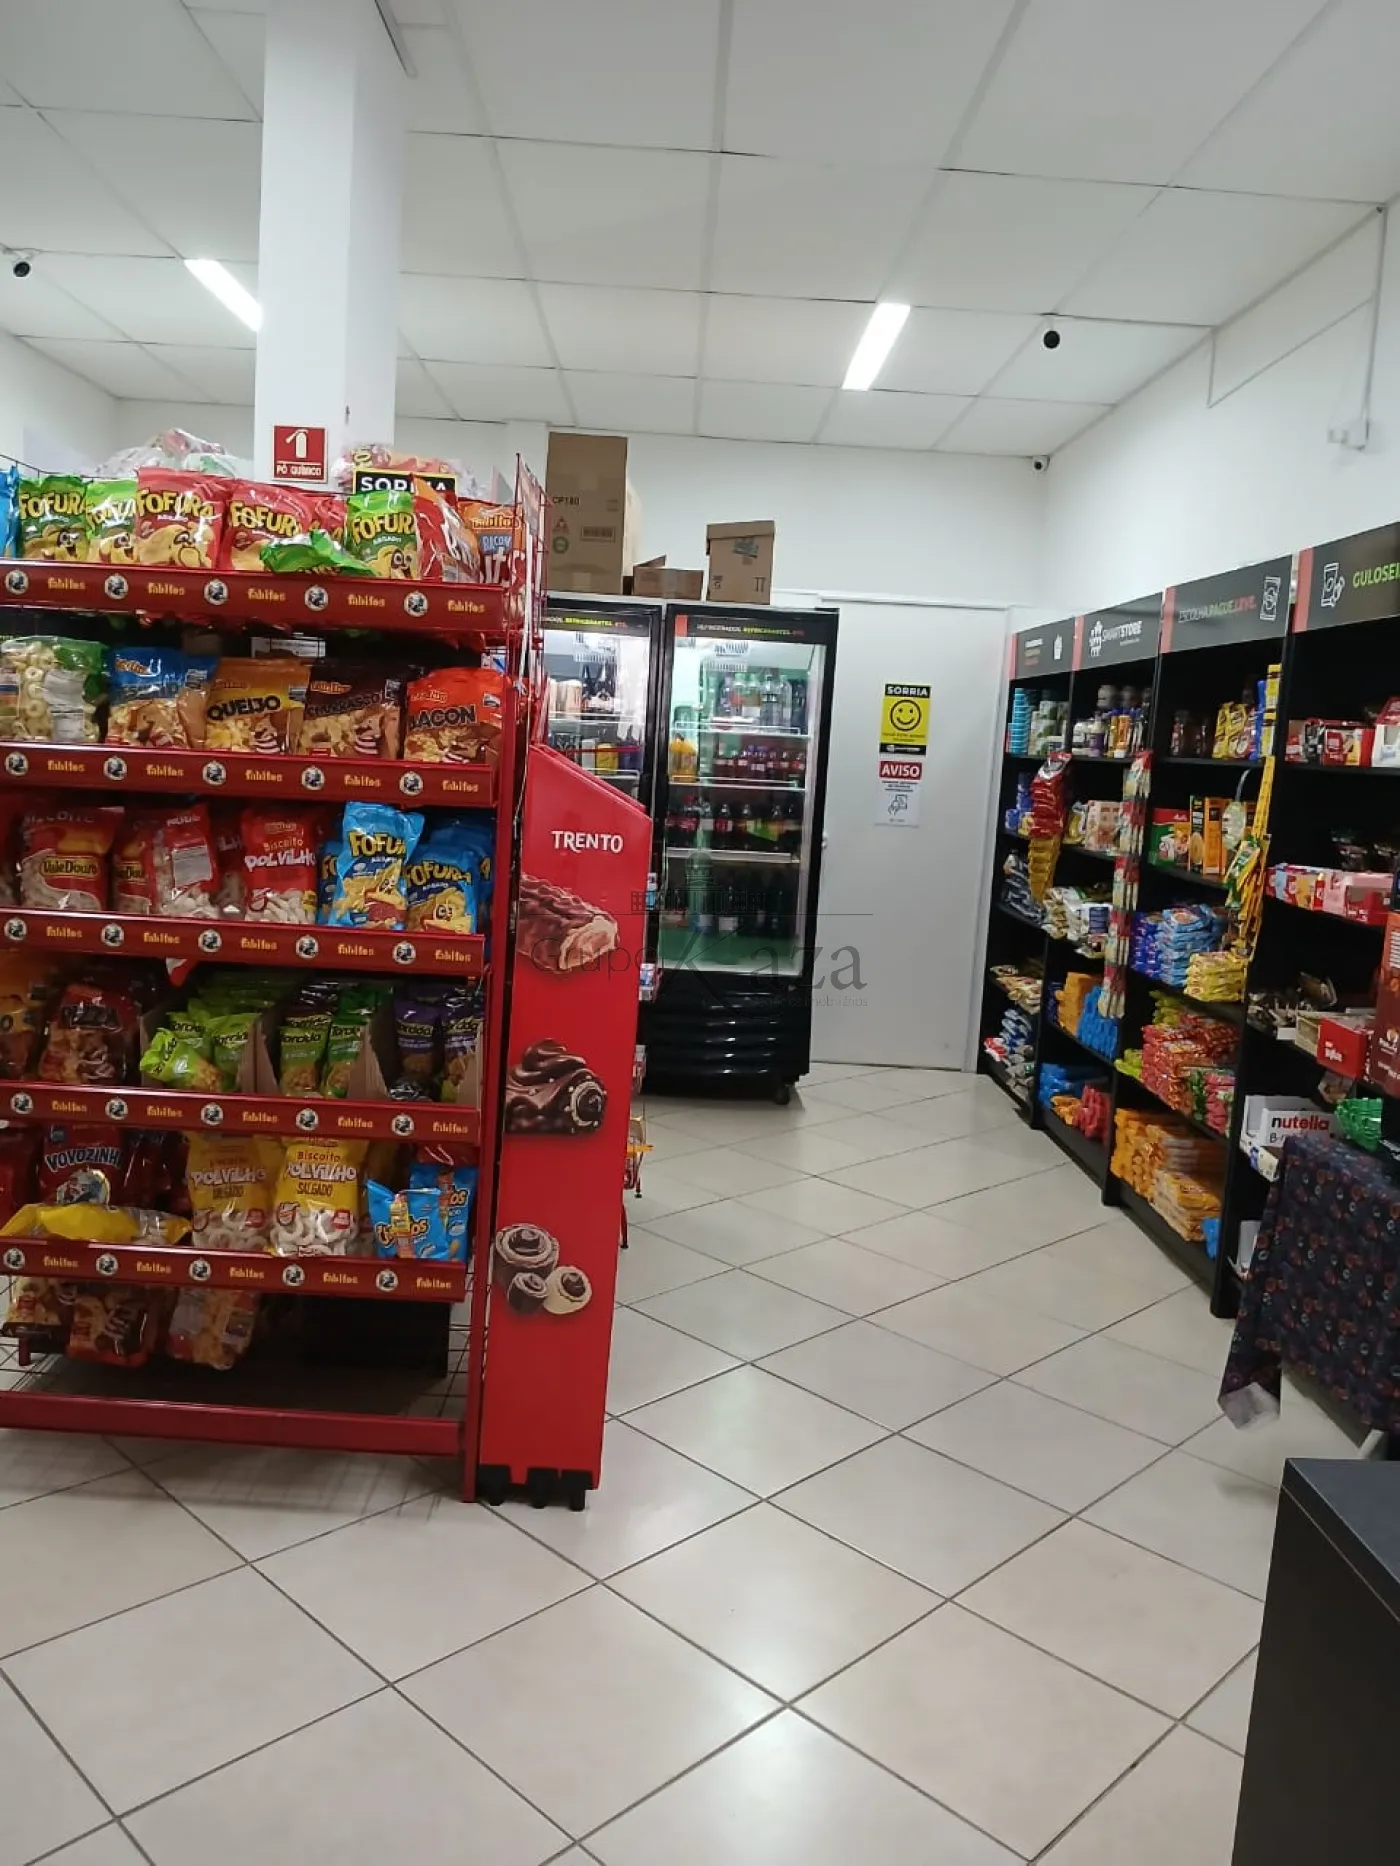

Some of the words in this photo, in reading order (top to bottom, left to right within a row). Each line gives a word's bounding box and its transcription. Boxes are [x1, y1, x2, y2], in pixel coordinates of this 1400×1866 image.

[887, 686, 928, 697] SORRIA
[207, 695, 280, 720] QUEIJO
[881, 763, 920, 778] AVISO
[551, 830, 624, 853] TRENTO
[1271, 1114, 1330, 1131] nutella
[297, 1151, 341, 1163] Biscoito
[297, 1182, 333, 1197] SALGADO
